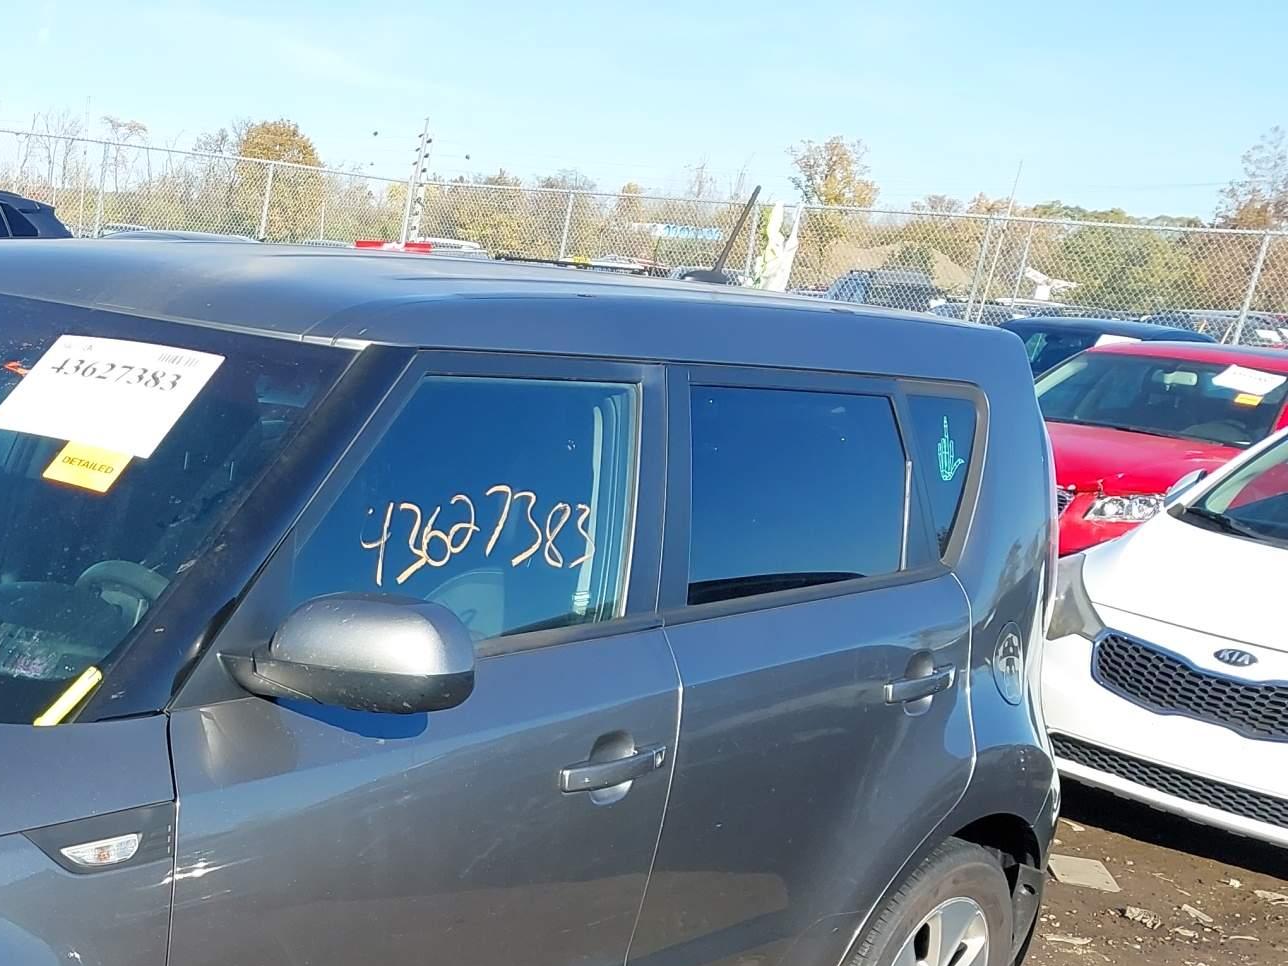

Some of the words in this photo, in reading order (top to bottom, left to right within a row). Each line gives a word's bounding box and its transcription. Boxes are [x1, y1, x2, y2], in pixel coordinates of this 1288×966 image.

[50, 357, 182, 391] 43627383
[62, 455, 115, 474] DETAILED
[360, 484, 596, 586] 43627383
[1219, 649, 1250, 665] KIA
